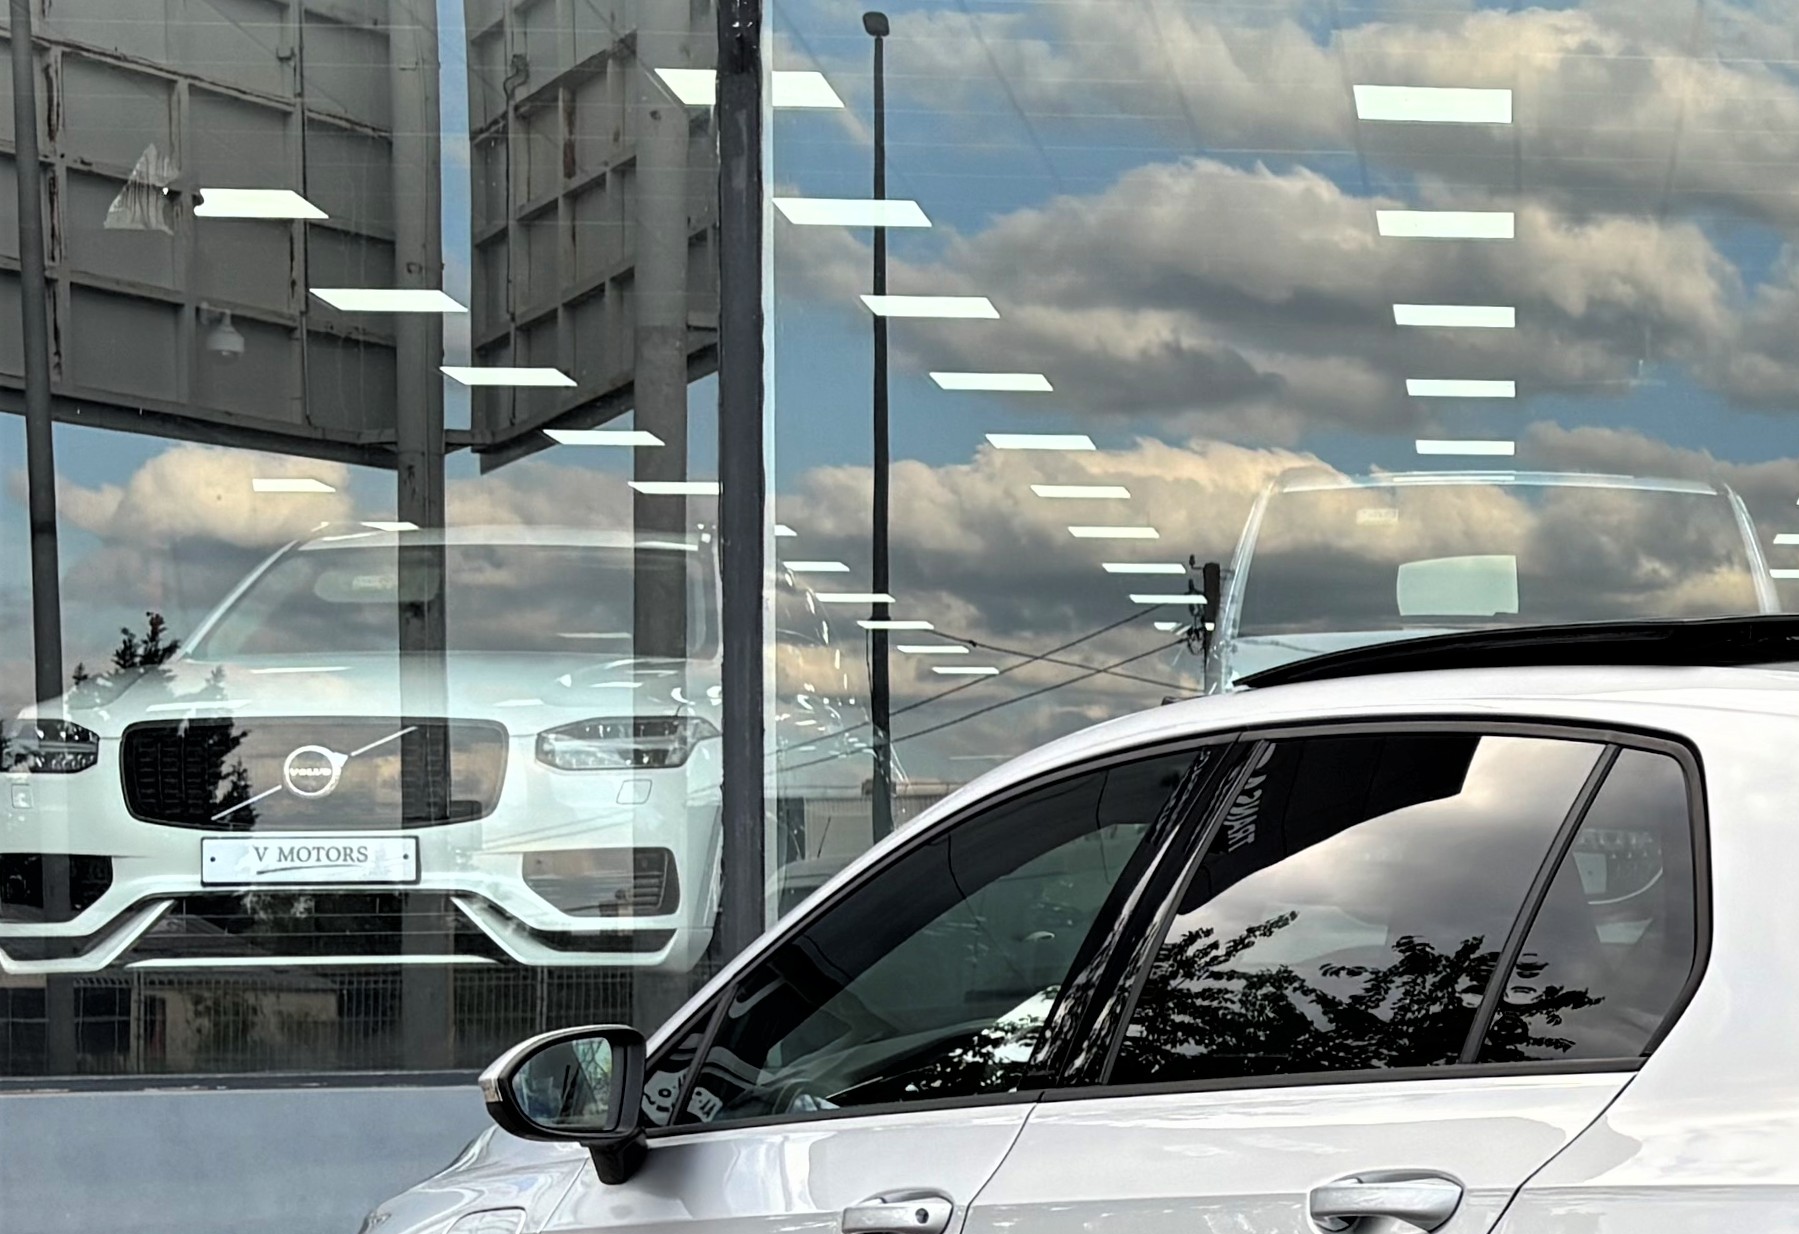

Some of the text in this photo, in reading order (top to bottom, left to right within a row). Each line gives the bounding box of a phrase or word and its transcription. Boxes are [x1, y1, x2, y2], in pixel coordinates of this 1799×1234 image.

[288, 766, 332, 777] VOLVO
[253, 846, 369, 863] V MOTORS
